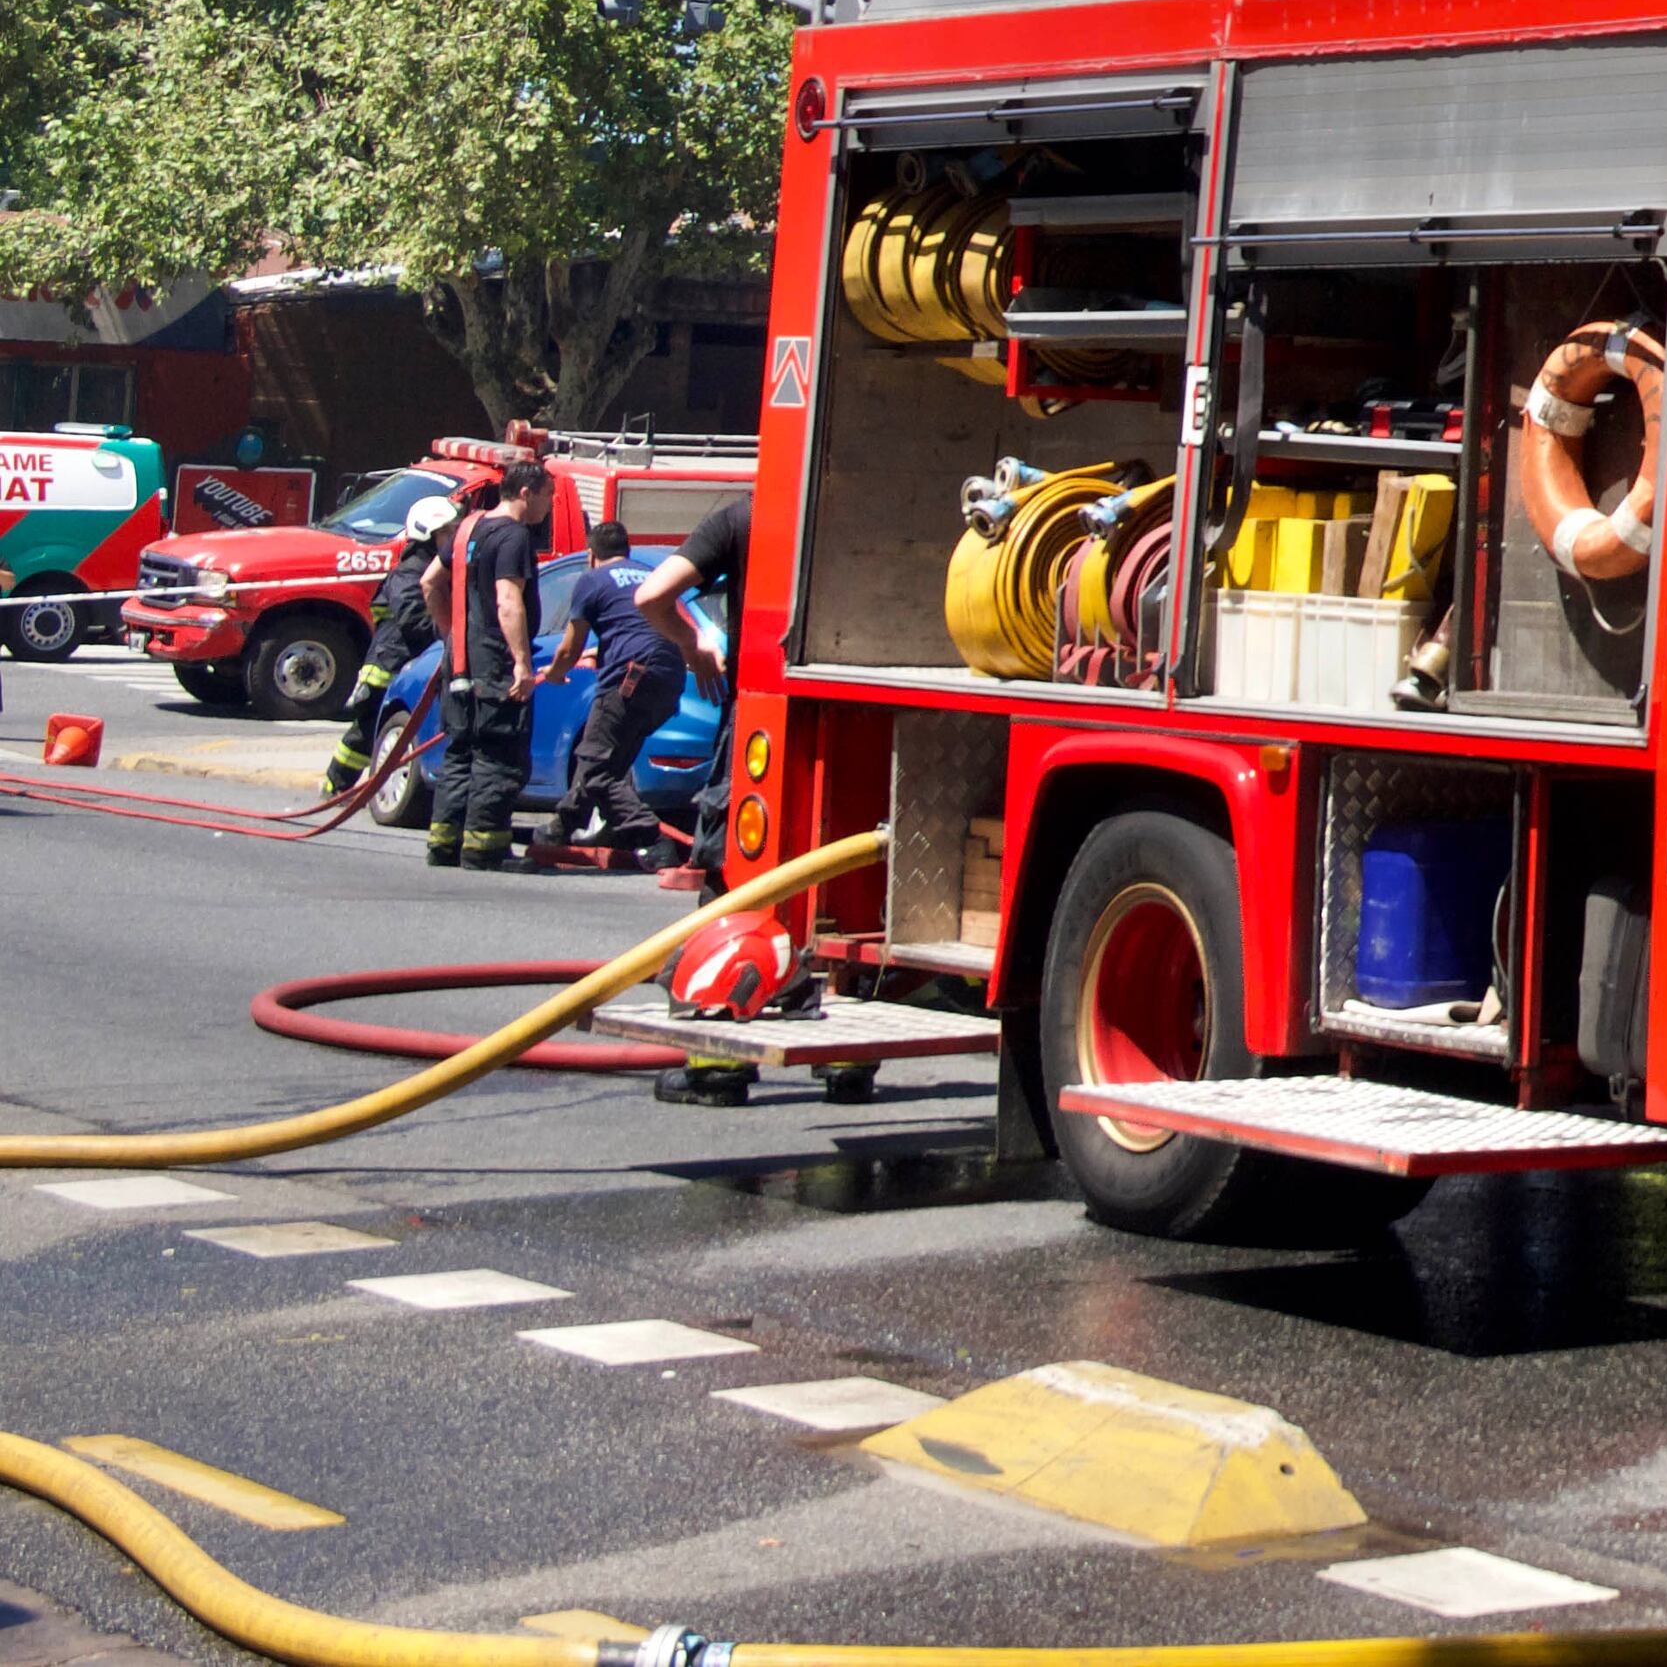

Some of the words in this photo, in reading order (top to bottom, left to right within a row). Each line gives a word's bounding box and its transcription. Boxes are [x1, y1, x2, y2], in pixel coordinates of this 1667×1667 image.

[0, 476, 54, 501] AT
[195, 474, 273, 525] YOUTUBE
[336, 550, 393, 572] 2657
